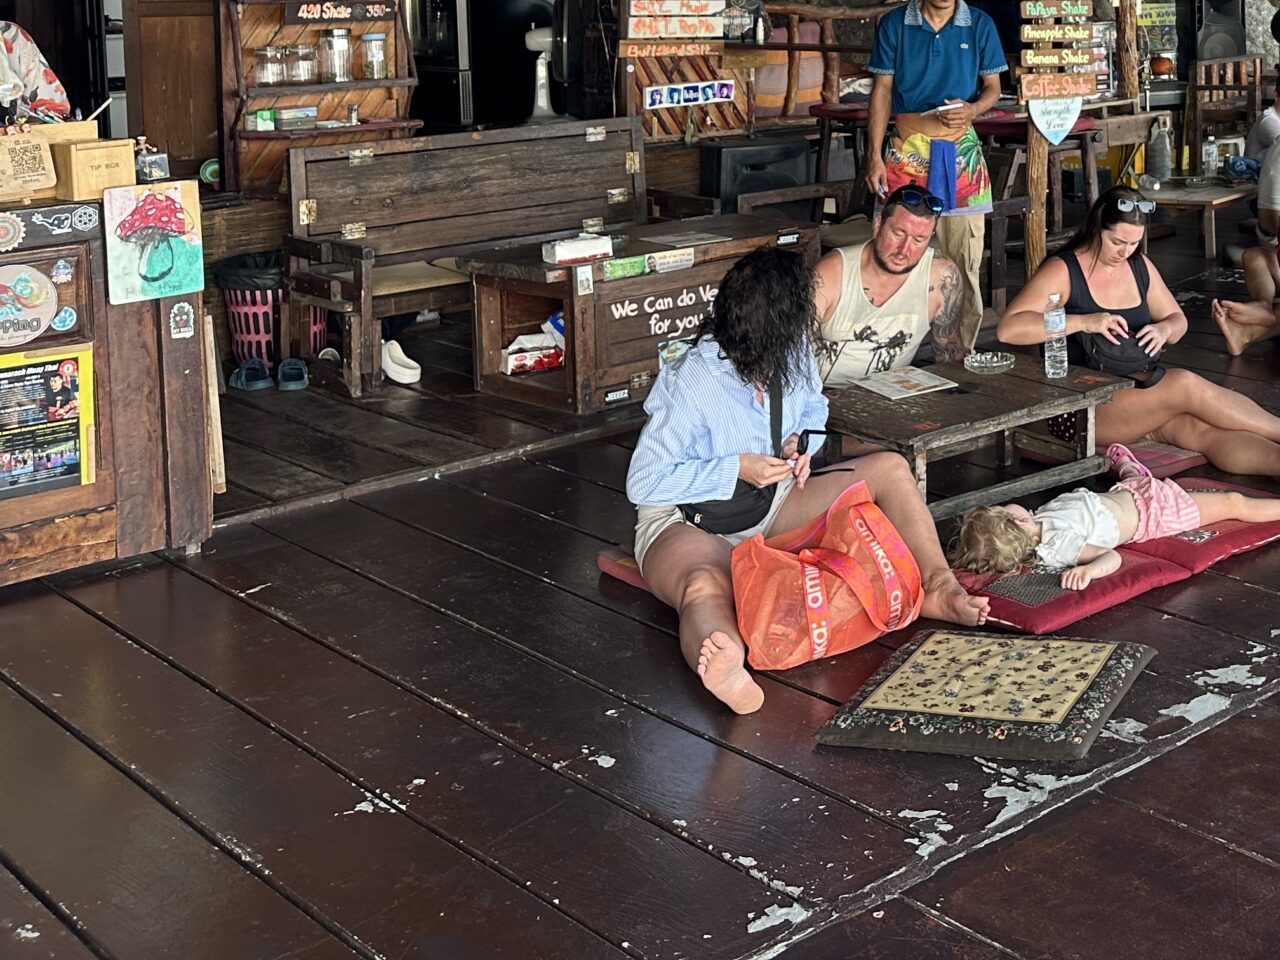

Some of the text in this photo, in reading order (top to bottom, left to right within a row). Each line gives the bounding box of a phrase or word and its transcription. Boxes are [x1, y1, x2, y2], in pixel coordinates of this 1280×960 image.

[298, 4, 321, 18] 420
[1061, 0, 1088, 14] Shake
[1064, 25, 1090, 39] Shake
[1026, 49, 1089, 64] Banana Shake
[1023, 75, 1092, 97] Coffee Shake
[105, 162, 120, 170] BOX
[611, 299, 638, 320] We
[644, 295, 674, 314] Can
[677, 289, 696, 308] do
[649, 313, 704, 338] for you
[855, 518, 895, 580] amika:
